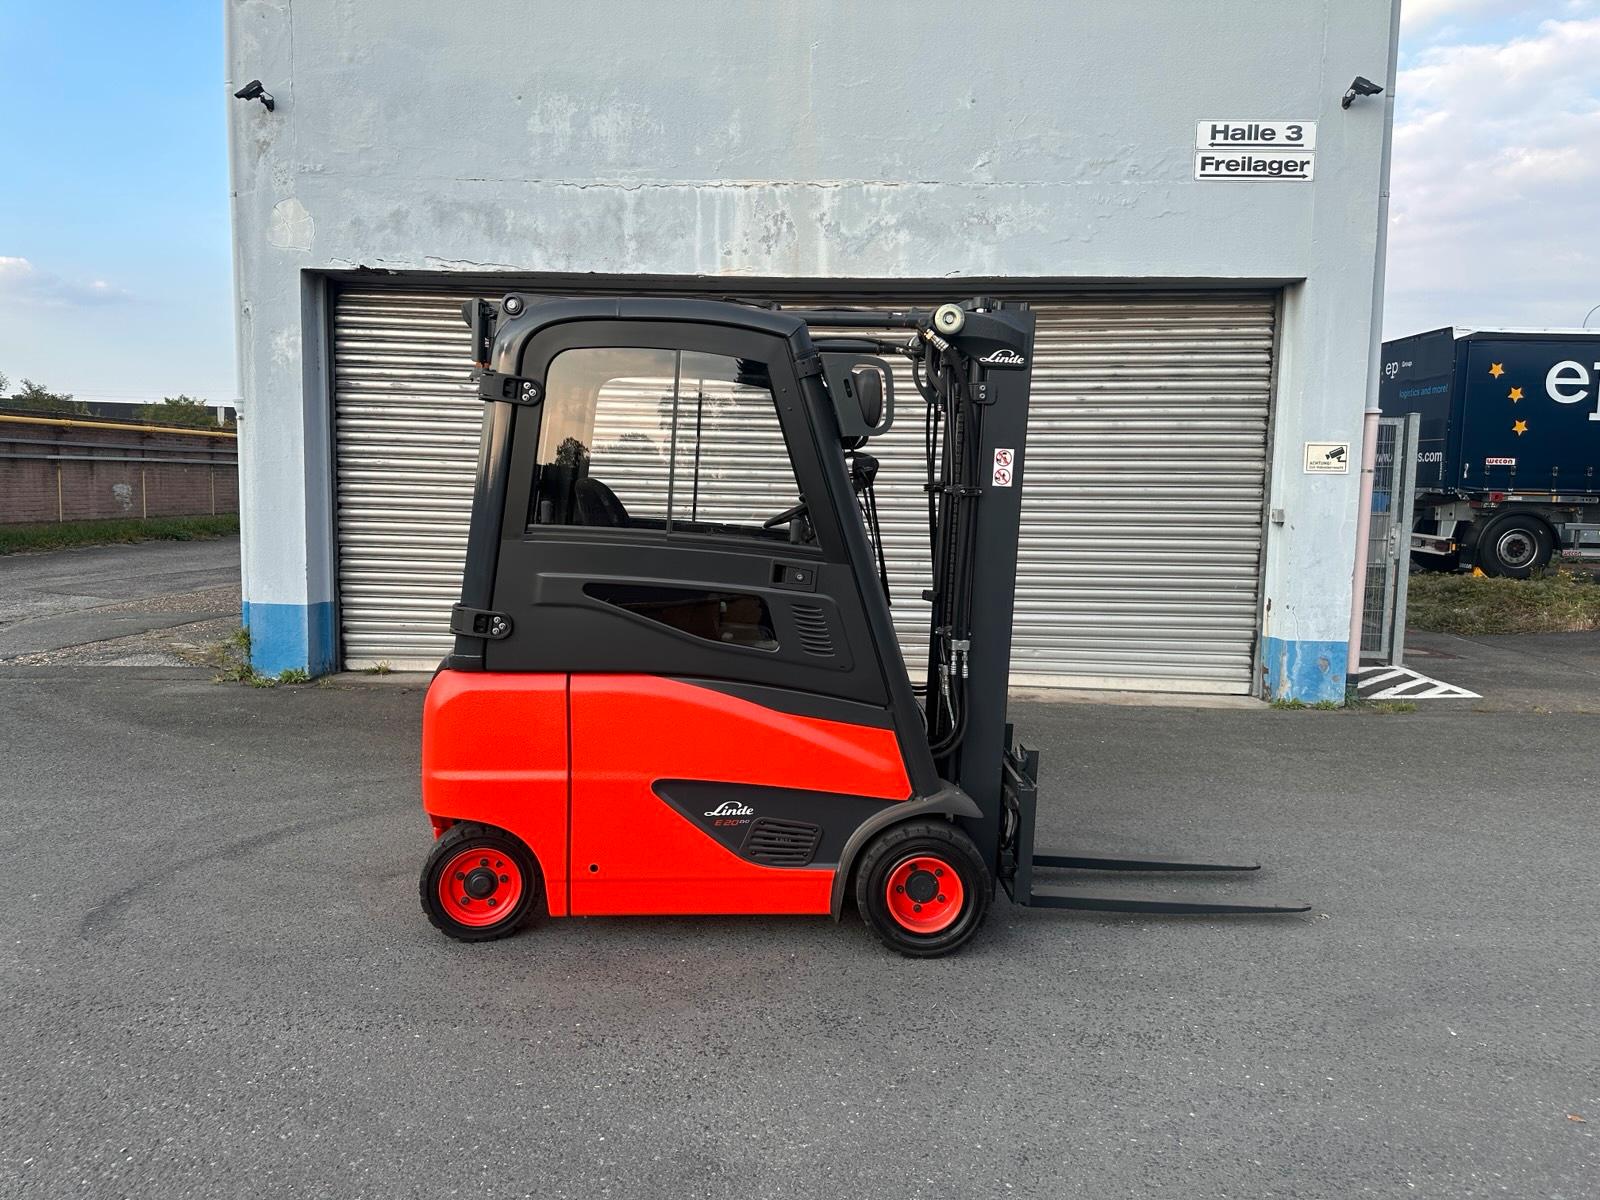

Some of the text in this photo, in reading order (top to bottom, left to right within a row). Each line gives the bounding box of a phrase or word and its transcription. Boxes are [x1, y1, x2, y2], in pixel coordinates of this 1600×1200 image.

[1210, 124, 1303, 141] Halle 3
[1200, 156, 1310, 176] Freilager
[980, 349, 1025, 364] Linde
[1385, 361, 1399, 379] ep
[704, 800, 754, 817] Linde
